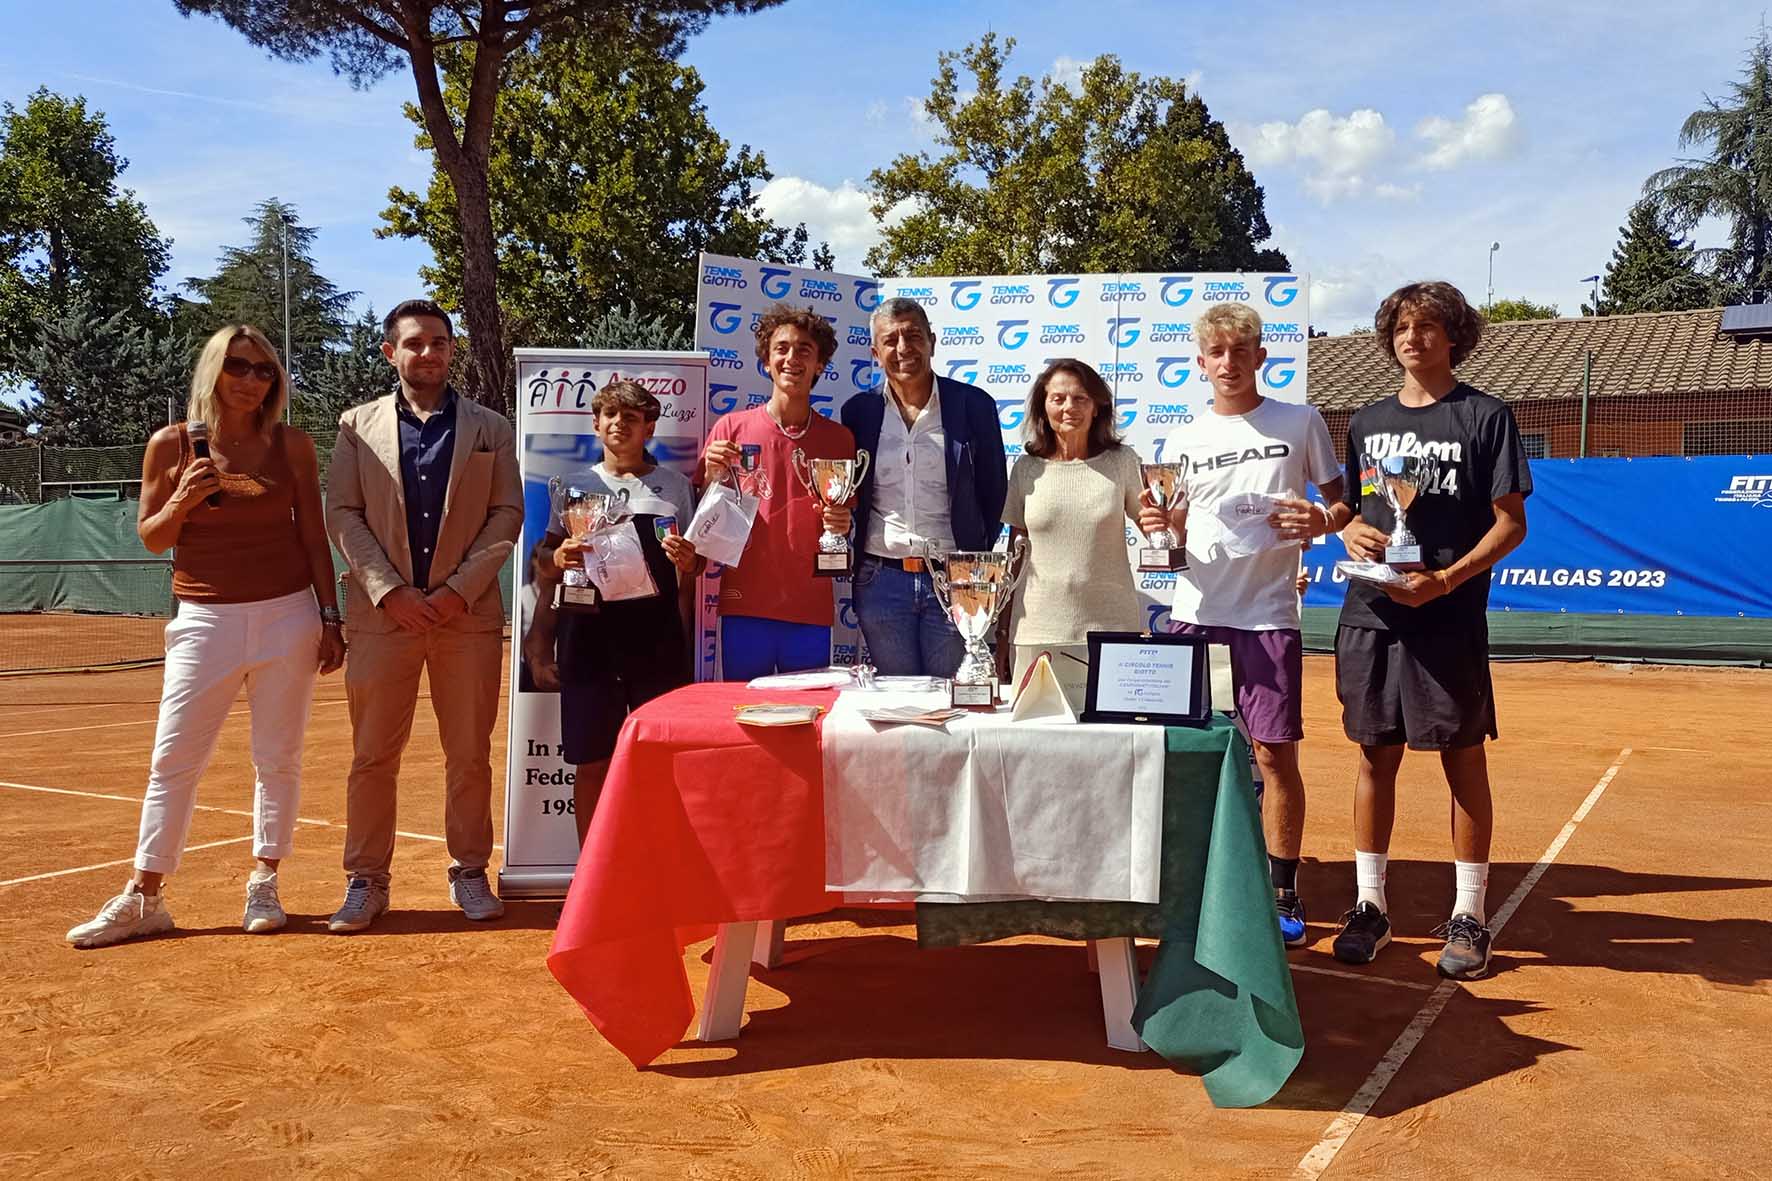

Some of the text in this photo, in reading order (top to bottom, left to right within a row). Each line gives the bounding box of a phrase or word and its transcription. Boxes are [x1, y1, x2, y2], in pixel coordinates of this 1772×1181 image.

[703, 265, 742, 279] TENNIS
[702, 275, 748, 289] GIOTTO
[800, 279, 838, 291] TENNIS
[1101, 282, 1141, 292] TENNIS
[1204, 282, 1245, 291] TENNIS
[896, 288, 933, 297] TENNIS
[992, 285, 1030, 294] TENNIS
[799, 288, 842, 302] GIOTTO
[990, 294, 1035, 304] GIOTTO
[1100, 292, 1146, 302] GIOTTO
[1202, 291, 1250, 302] GIOTTO
[942, 327, 979, 336] TENNIS
[1041, 324, 1080, 334] TENNIS
[1152, 323, 1191, 333] TENNIS
[1263, 323, 1299, 333] ENNIS
[940, 336, 984, 346] GIOTTO
[1040, 334, 1085, 344] GIOTTO
[710, 358, 743, 370] OTTO
[988, 365, 1026, 374] TENNIS
[987, 374, 1032, 384] GIOTTO
[660, 402, 697, 423] Luzzi
[1148, 405, 1189, 414] TENNIS
[1146, 414, 1194, 425] GIOTTO
[1364, 432, 1462, 462] Wilson
[1192, 444, 1290, 474] HEAD
[1729, 475, 1772, 490] FIT
[1500, 568, 1602, 587] ITALGAS
[1607, 570, 1666, 587] 2023
[1140, 580, 1178, 590] GIOTT
[527, 739, 549, 756] In
[525, 768, 576, 786] Fede
[542, 799, 576, 816] 198
